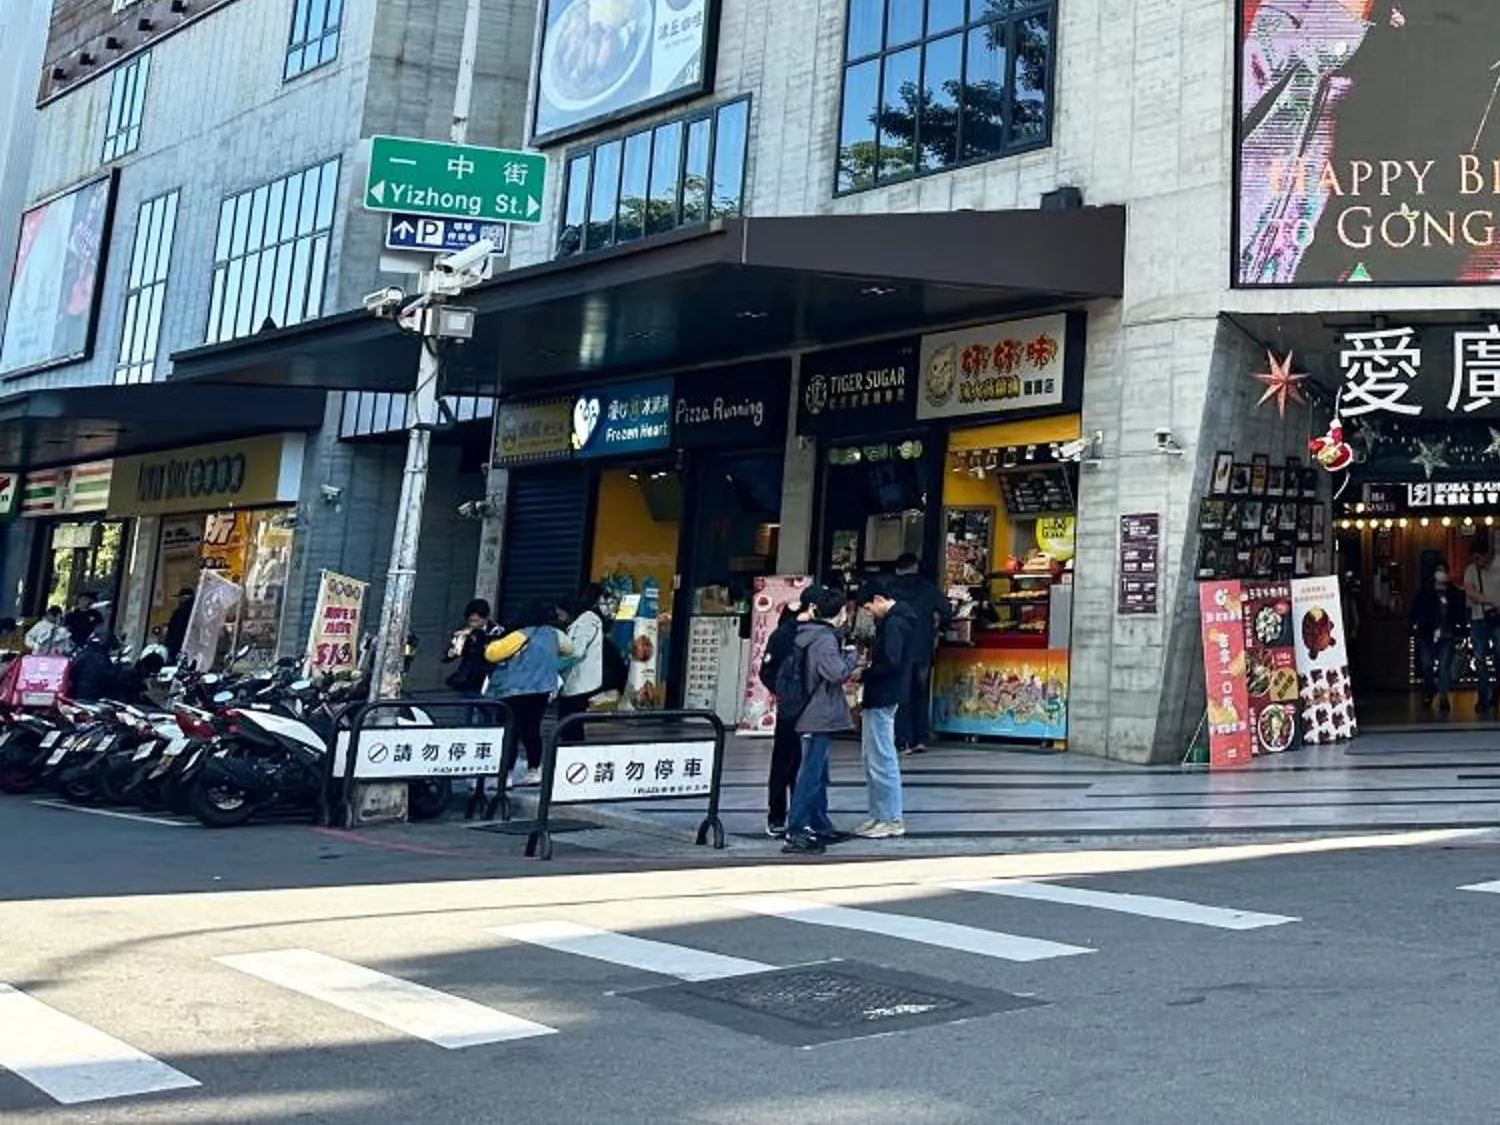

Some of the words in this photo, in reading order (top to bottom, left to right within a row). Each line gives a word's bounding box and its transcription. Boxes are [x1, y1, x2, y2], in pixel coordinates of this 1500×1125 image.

[389, 154, 529, 187] 一中街
[390, 183, 482, 216] Yizhong
[495, 194, 524, 215] St.
[830, 372, 864, 395] TIGER
[865, 365, 905, 390] SUGAR
[675, 398, 710, 425] Pizza
[713, 395, 764, 427] Running
[393, 742, 494, 763] 請勿停車
[594, 758, 704, 782] 請勿停車
